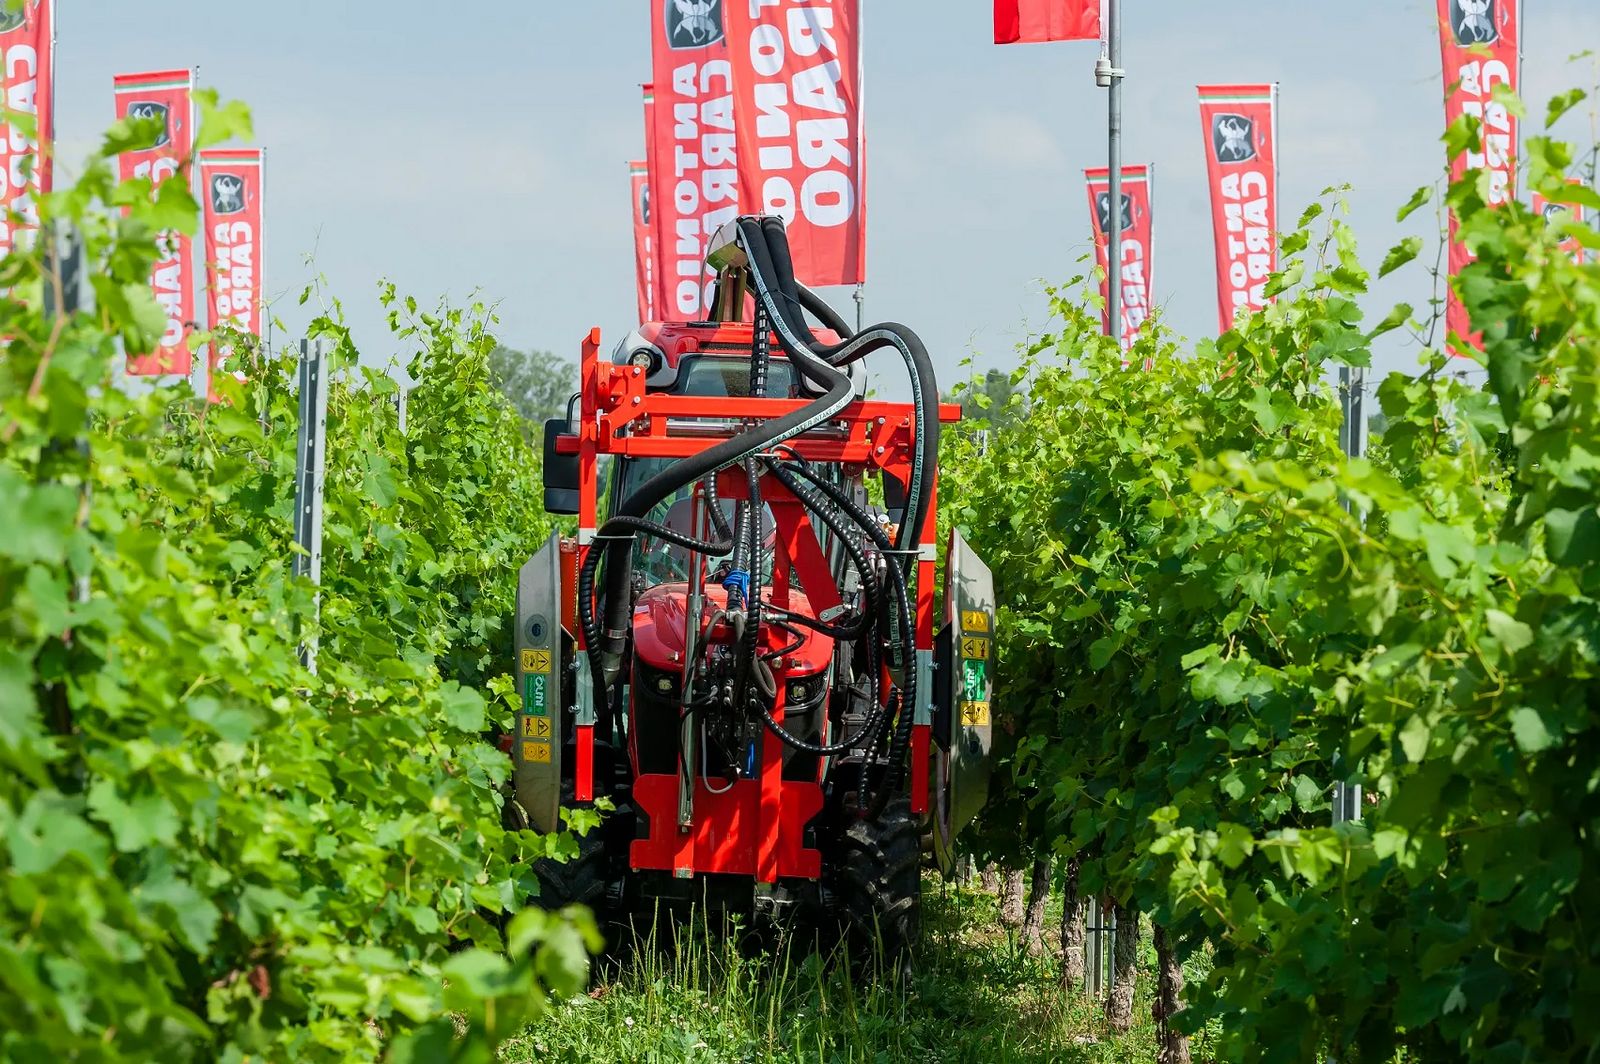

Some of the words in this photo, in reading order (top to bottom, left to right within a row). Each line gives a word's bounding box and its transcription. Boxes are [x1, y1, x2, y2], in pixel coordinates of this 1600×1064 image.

[788, 420, 813, 437] WATER
[813, 409, 833, 423] INTAKE
[911, 472, 920, 501] WATER
